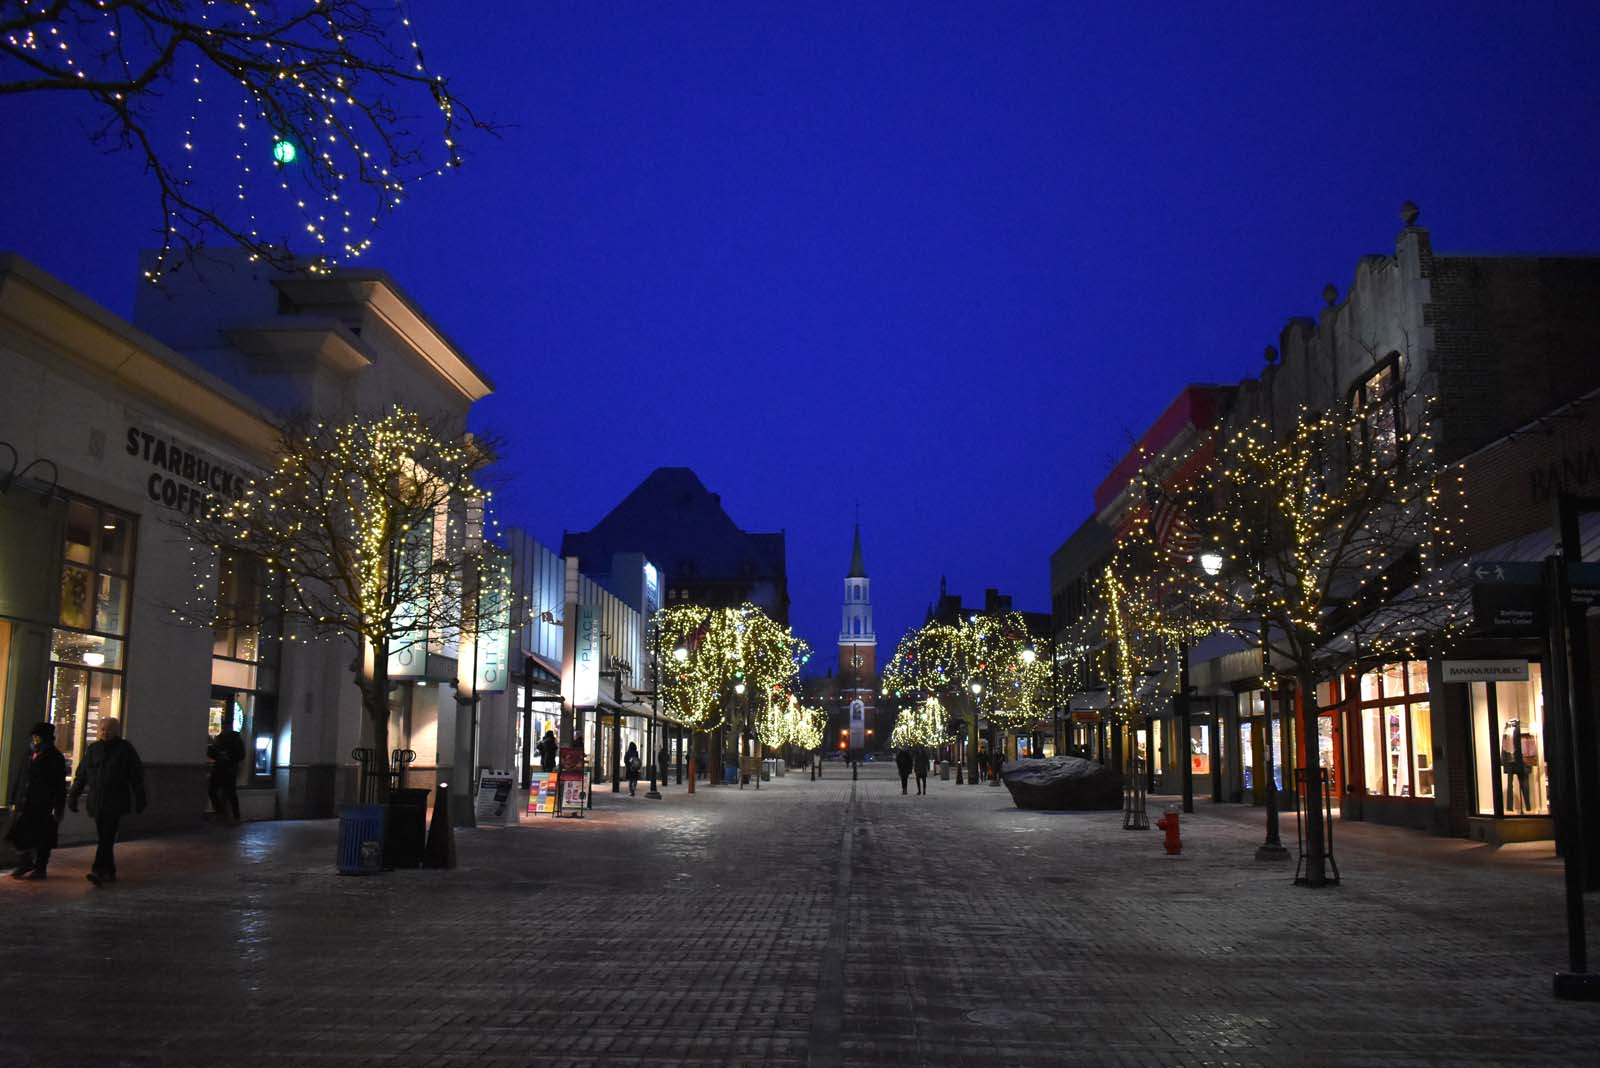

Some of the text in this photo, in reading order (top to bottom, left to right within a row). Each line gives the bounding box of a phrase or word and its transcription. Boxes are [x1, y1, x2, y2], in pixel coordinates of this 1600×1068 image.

[126, 427, 245, 499] STARBUCKS
[148, 473, 223, 524] COFF
[1450, 666, 1521, 676] BANANA REPUBLIC
